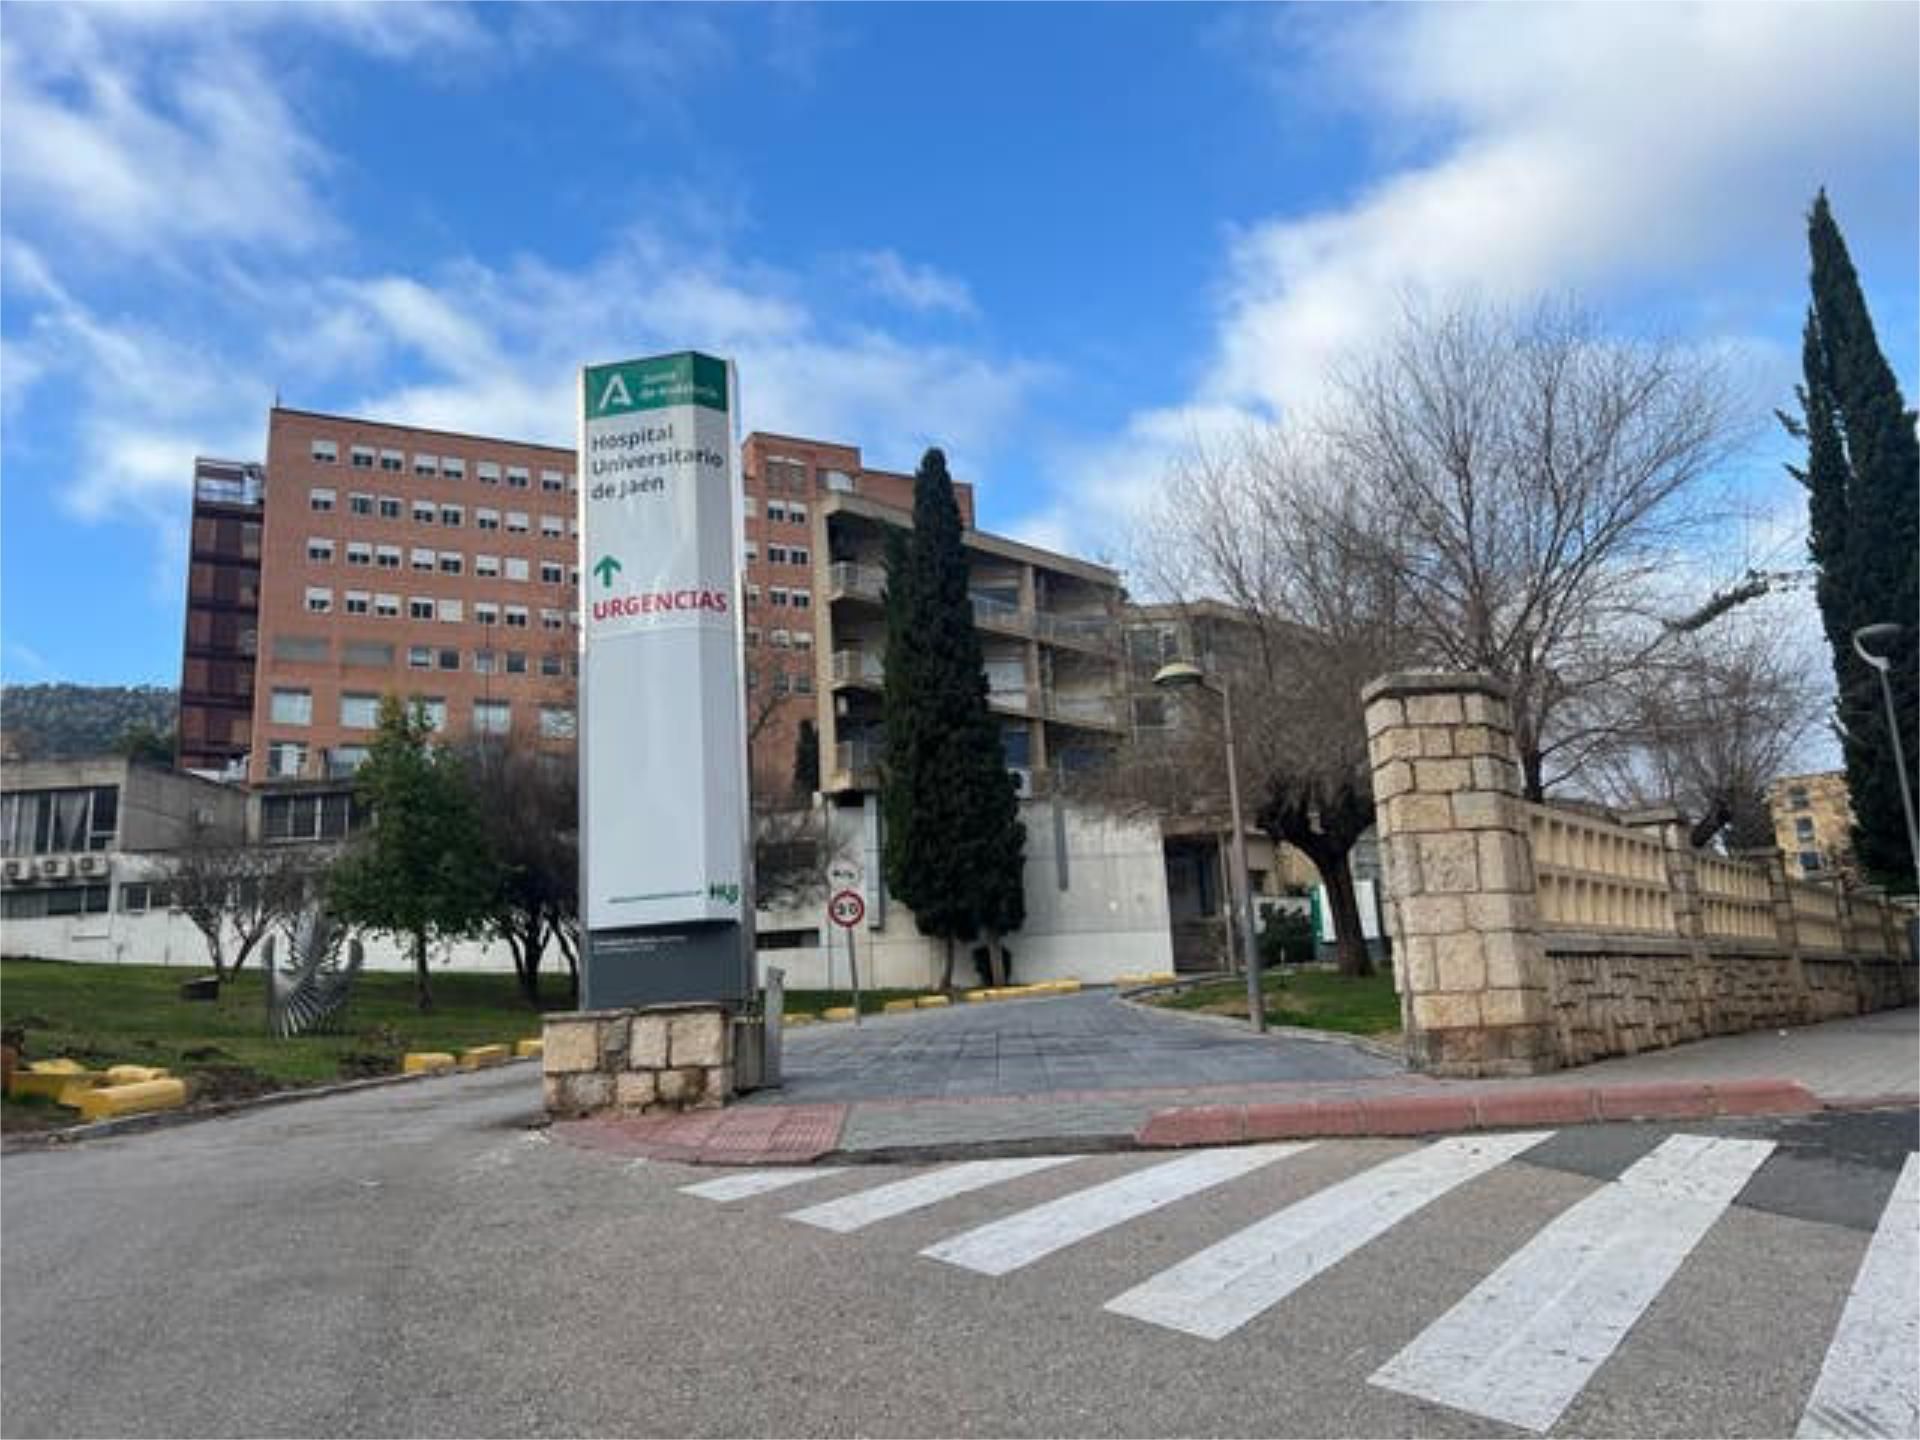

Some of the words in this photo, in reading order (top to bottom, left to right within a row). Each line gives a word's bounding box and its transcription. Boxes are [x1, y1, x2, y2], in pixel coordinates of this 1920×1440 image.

[592, 422, 673, 452] Hospital
[593, 447, 724, 475] Universitario
[591, 482, 617, 500] de
[618, 477, 665, 499] Jaén
[594, 589, 727, 620] URGENCIAS
